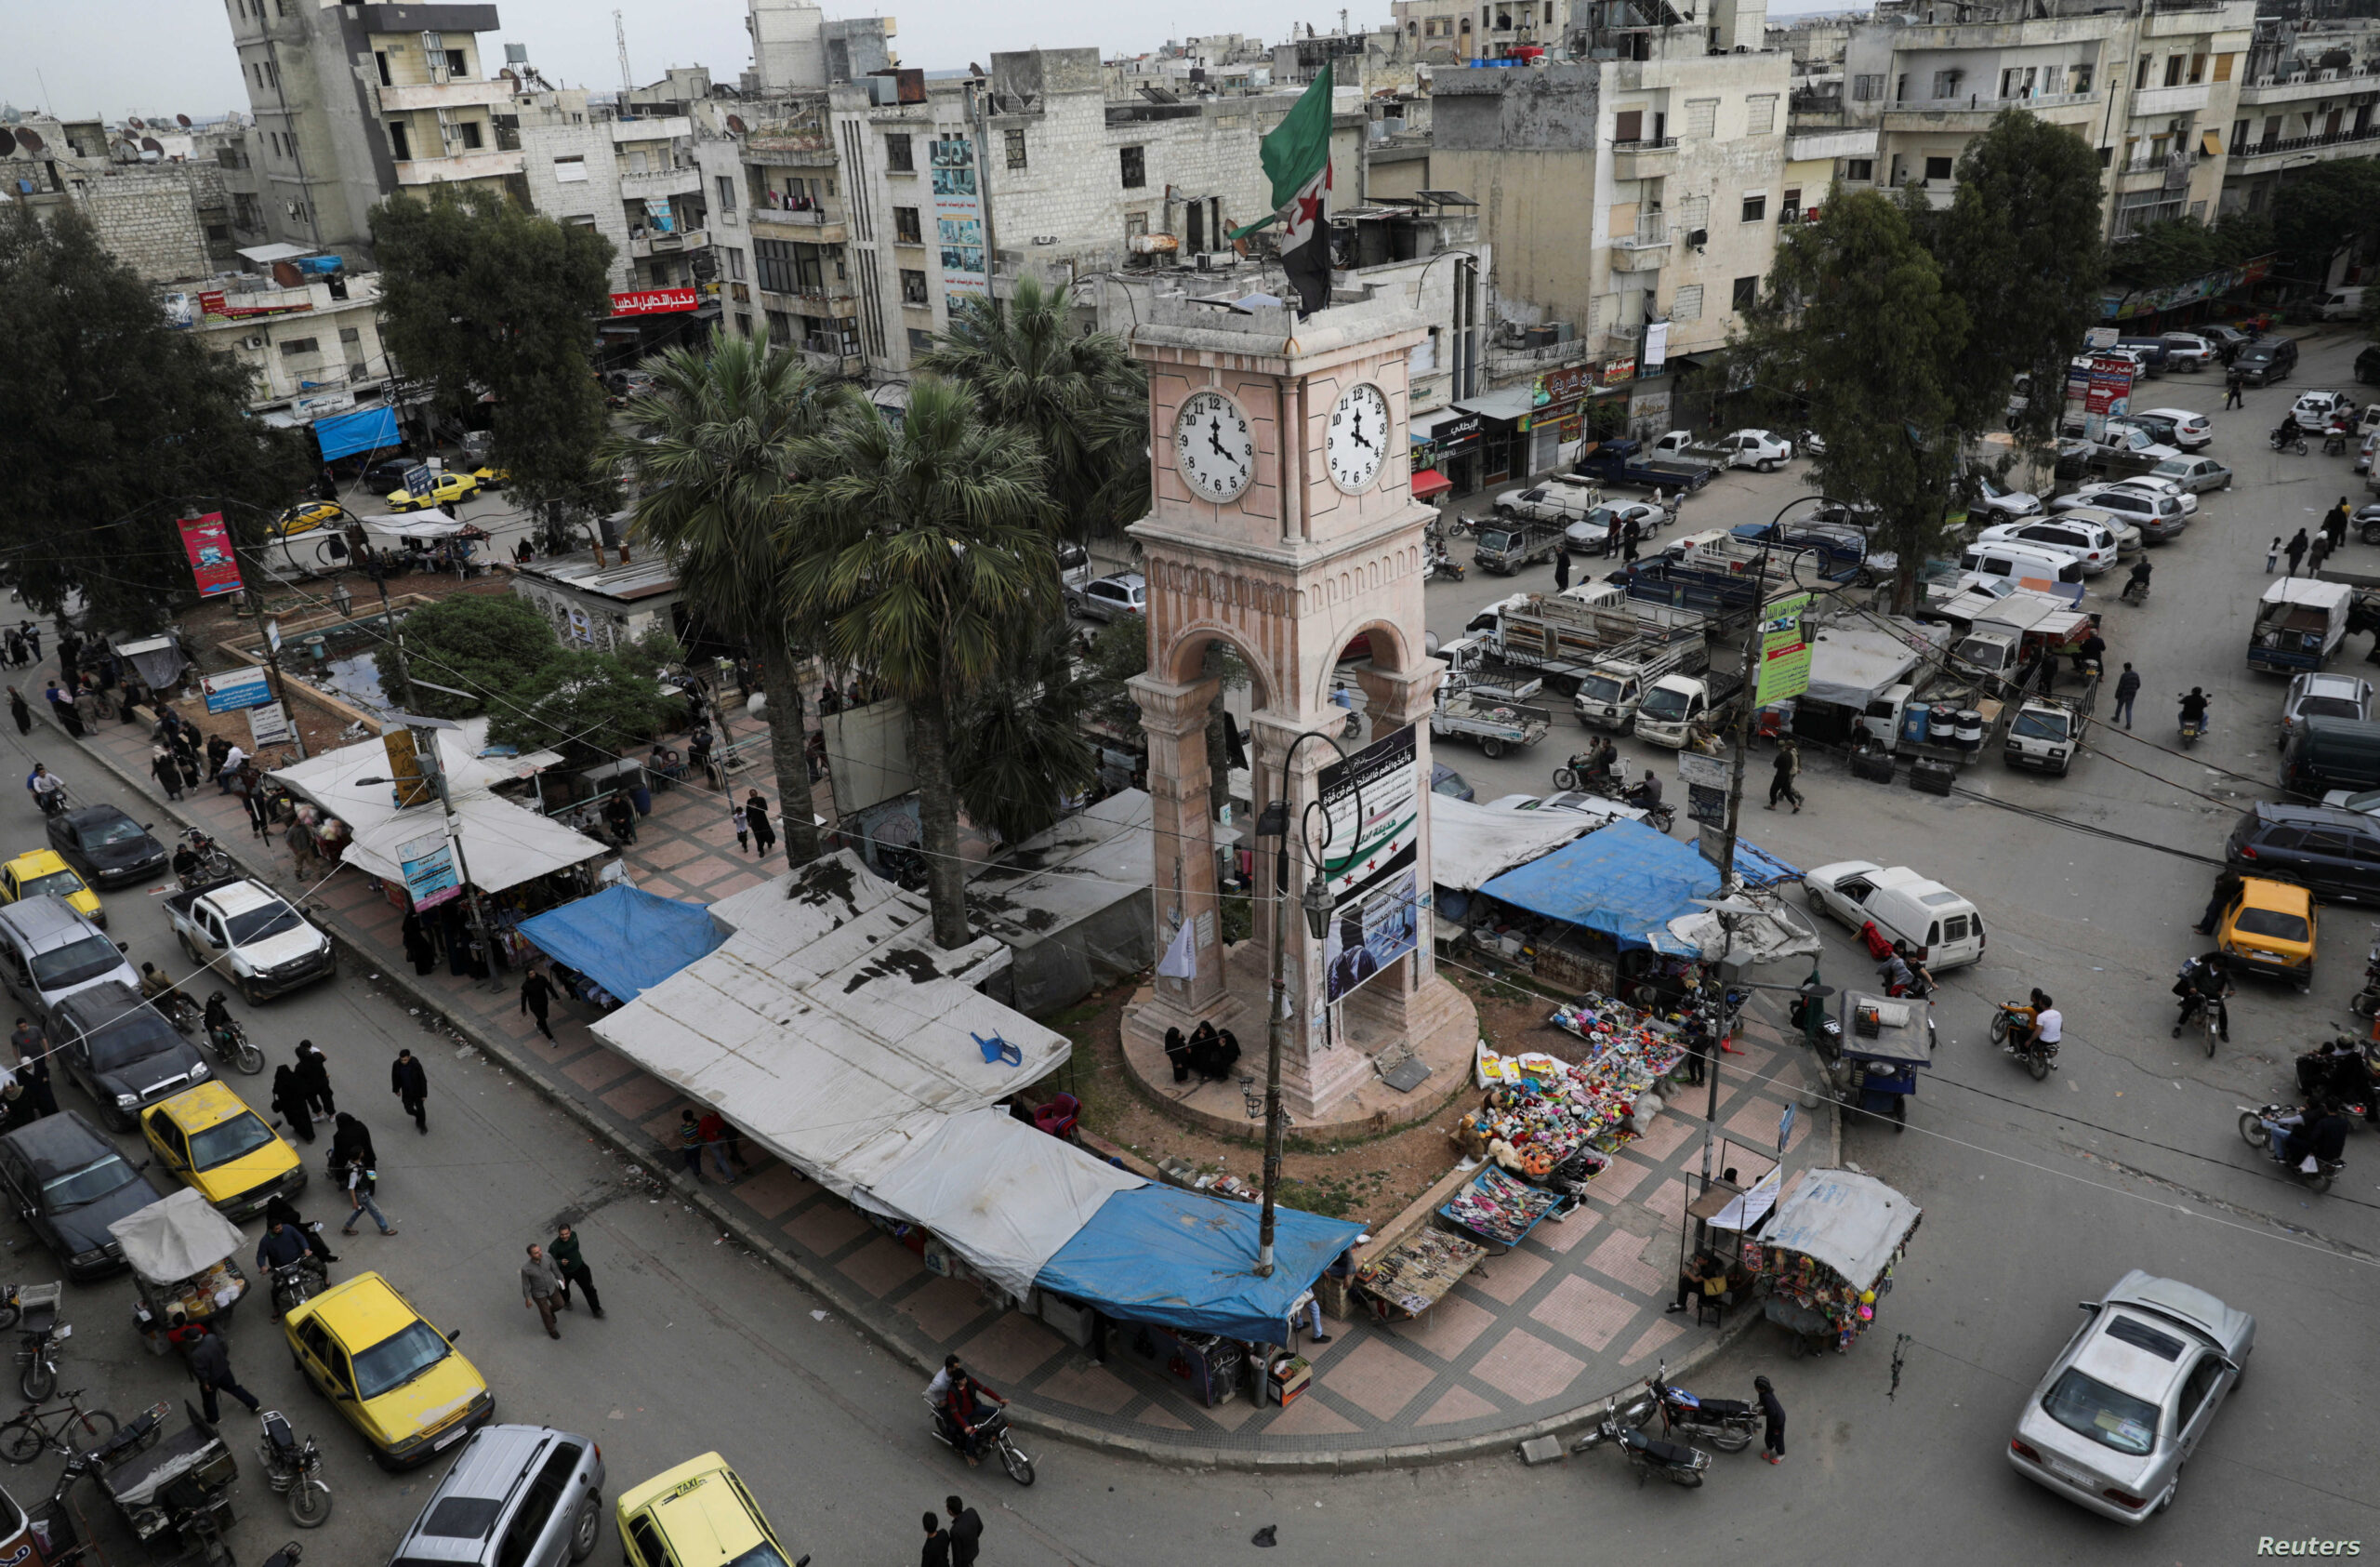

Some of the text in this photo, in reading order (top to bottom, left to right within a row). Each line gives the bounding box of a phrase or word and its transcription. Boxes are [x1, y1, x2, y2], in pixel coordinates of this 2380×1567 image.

[640, 294, 670, 311] التحاليل
[670, 292, 694, 309] مخبر
[1352, 388, 1363, 401] 12
[1368, 392, 1372, 404] 1
[1194, 403, 1205, 415] 11
[1209, 397, 1221, 409] 12
[1340, 398, 1348, 410] 11
[1375, 403, 1382, 415] 2
[1227, 405, 1235, 418] 1
[1185, 414, 1197, 426] 10
[1238, 419, 1246, 432] 2
[1332, 413, 1341, 426] 10
[1379, 423, 1385, 434] 3
[1182, 434, 1189, 446] 9
[1328, 437, 1333, 449] 9
[1245, 444, 1252, 456] 3
[1374, 446, 1379, 458] 4
[1188, 456, 1195, 468] 8
[1331, 458, 1337, 470] 8
[1366, 462, 1371, 474] 5
[1239, 464, 1247, 476] 4
[1341, 470, 1347, 482] 7
[1200, 472, 1207, 484] 7
[1230, 476, 1236, 488] 5
[1354, 471, 1359, 483] 6
[1215, 479, 1222, 491] 6
[1346, 769, 1372, 794] استطتم
[677, 1478, 697, 1494] TAXI
